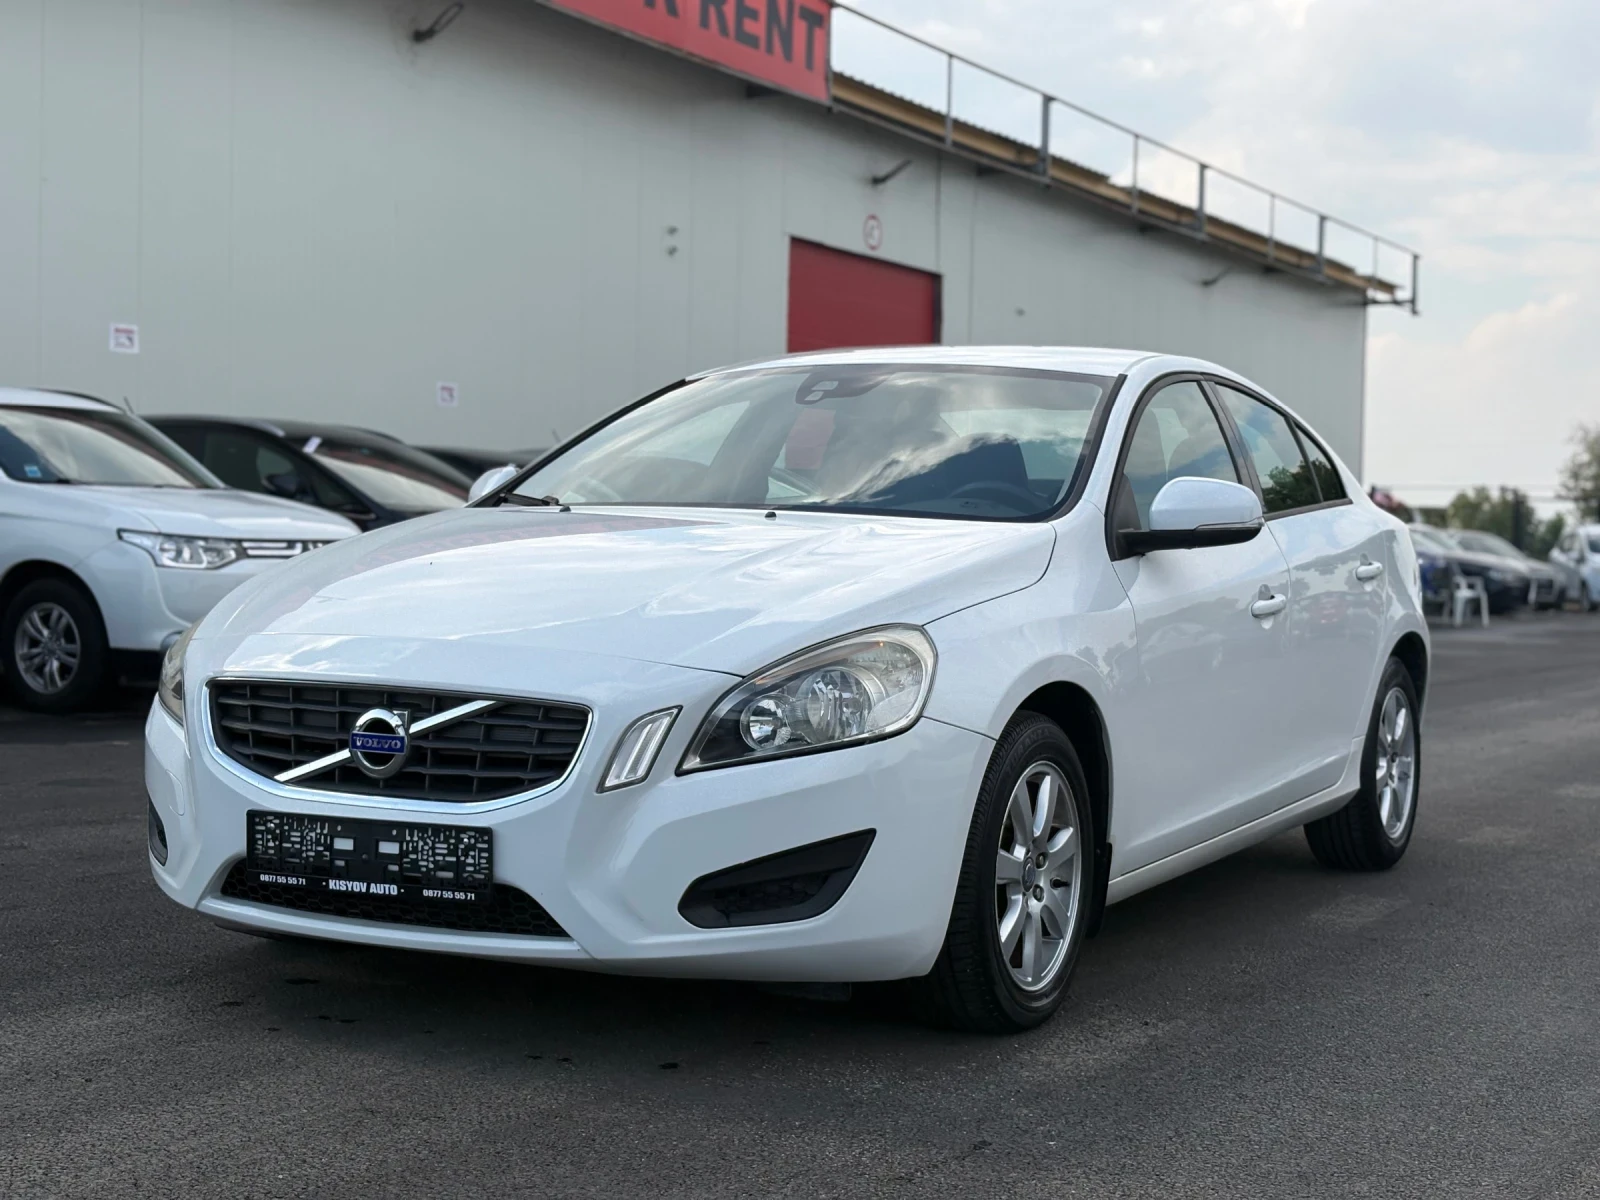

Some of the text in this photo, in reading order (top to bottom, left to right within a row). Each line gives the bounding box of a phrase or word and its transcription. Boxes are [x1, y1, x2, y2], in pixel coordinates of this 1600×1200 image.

[699, 0, 824, 72] RENT
[352, 736, 402, 749] VOLVO
[259, 873, 475, 901] 0877 55 55 71 KISYOV AUTO 0877 55 55 71
